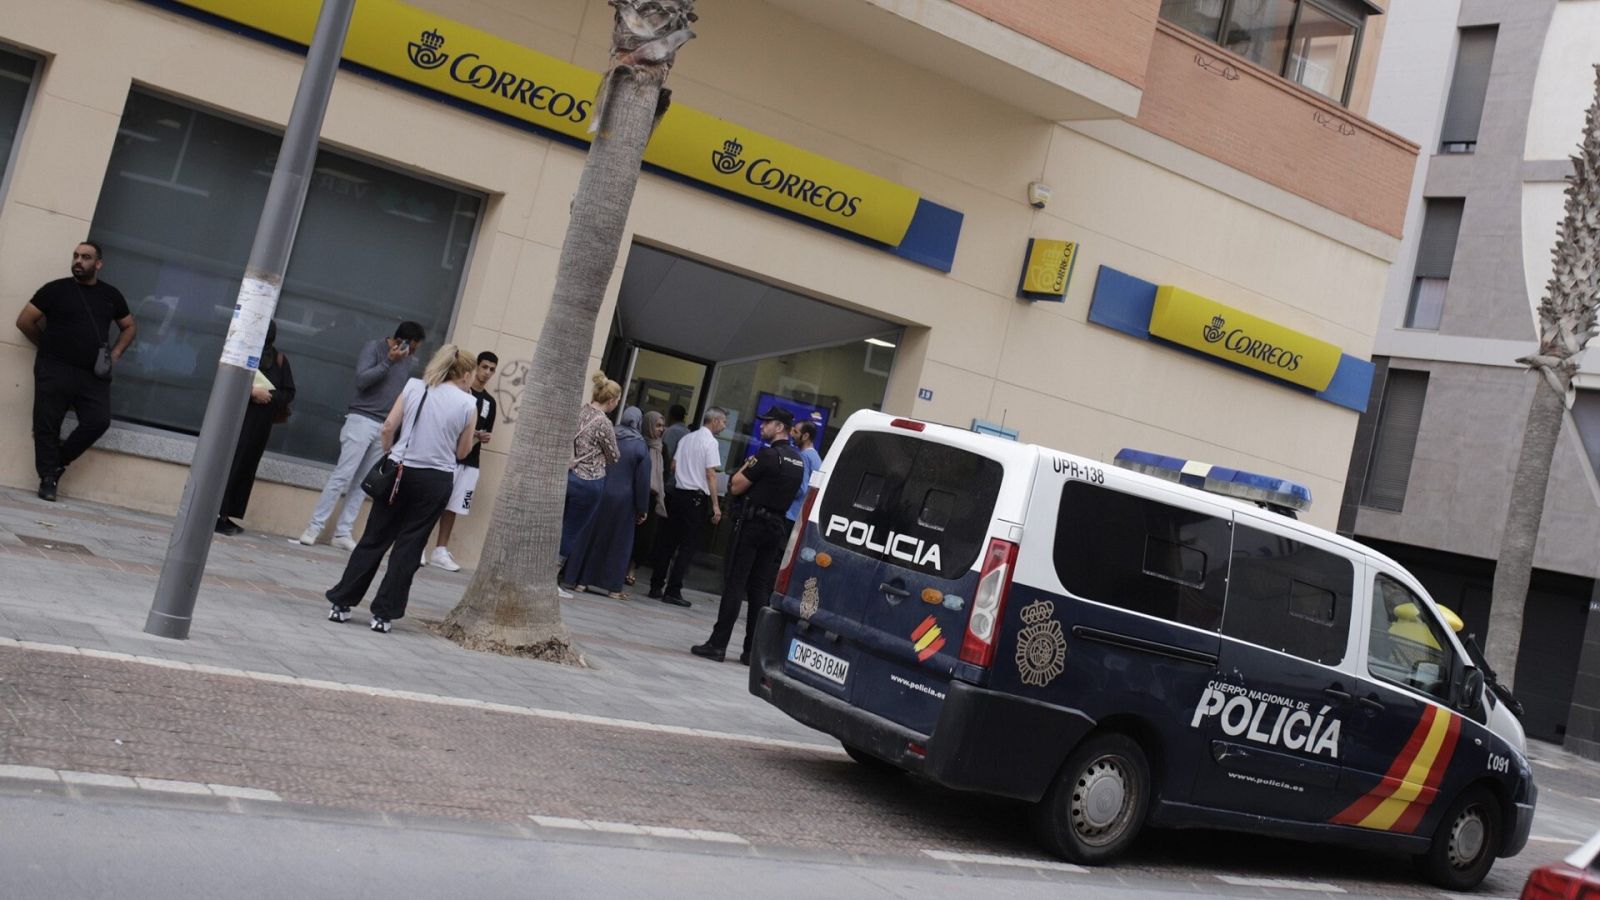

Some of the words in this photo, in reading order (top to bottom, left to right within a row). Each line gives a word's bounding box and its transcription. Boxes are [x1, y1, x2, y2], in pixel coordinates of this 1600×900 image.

[449, 53, 592, 123] CORREOS
[745, 158, 862, 217] CORREOS
[1052, 240, 1073, 292] CORREOS
[1225, 328, 1303, 371] CORREOS
[1053, 456, 1104, 484] UPR-138
[825, 515, 941, 570] POLICIA
[793, 644, 847, 681] CNP3618AM
[890, 673, 946, 700] www.policia.es
[1207, 680, 1248, 697] CUERPO
[1248, 690, 1295, 708] NACIONAL
[1296, 701, 1310, 712] DE
[1191, 688, 1342, 758] POLICÍA
[1228, 771, 1304, 792] www.policia.es
[1492, 755, 1510, 774] 091
